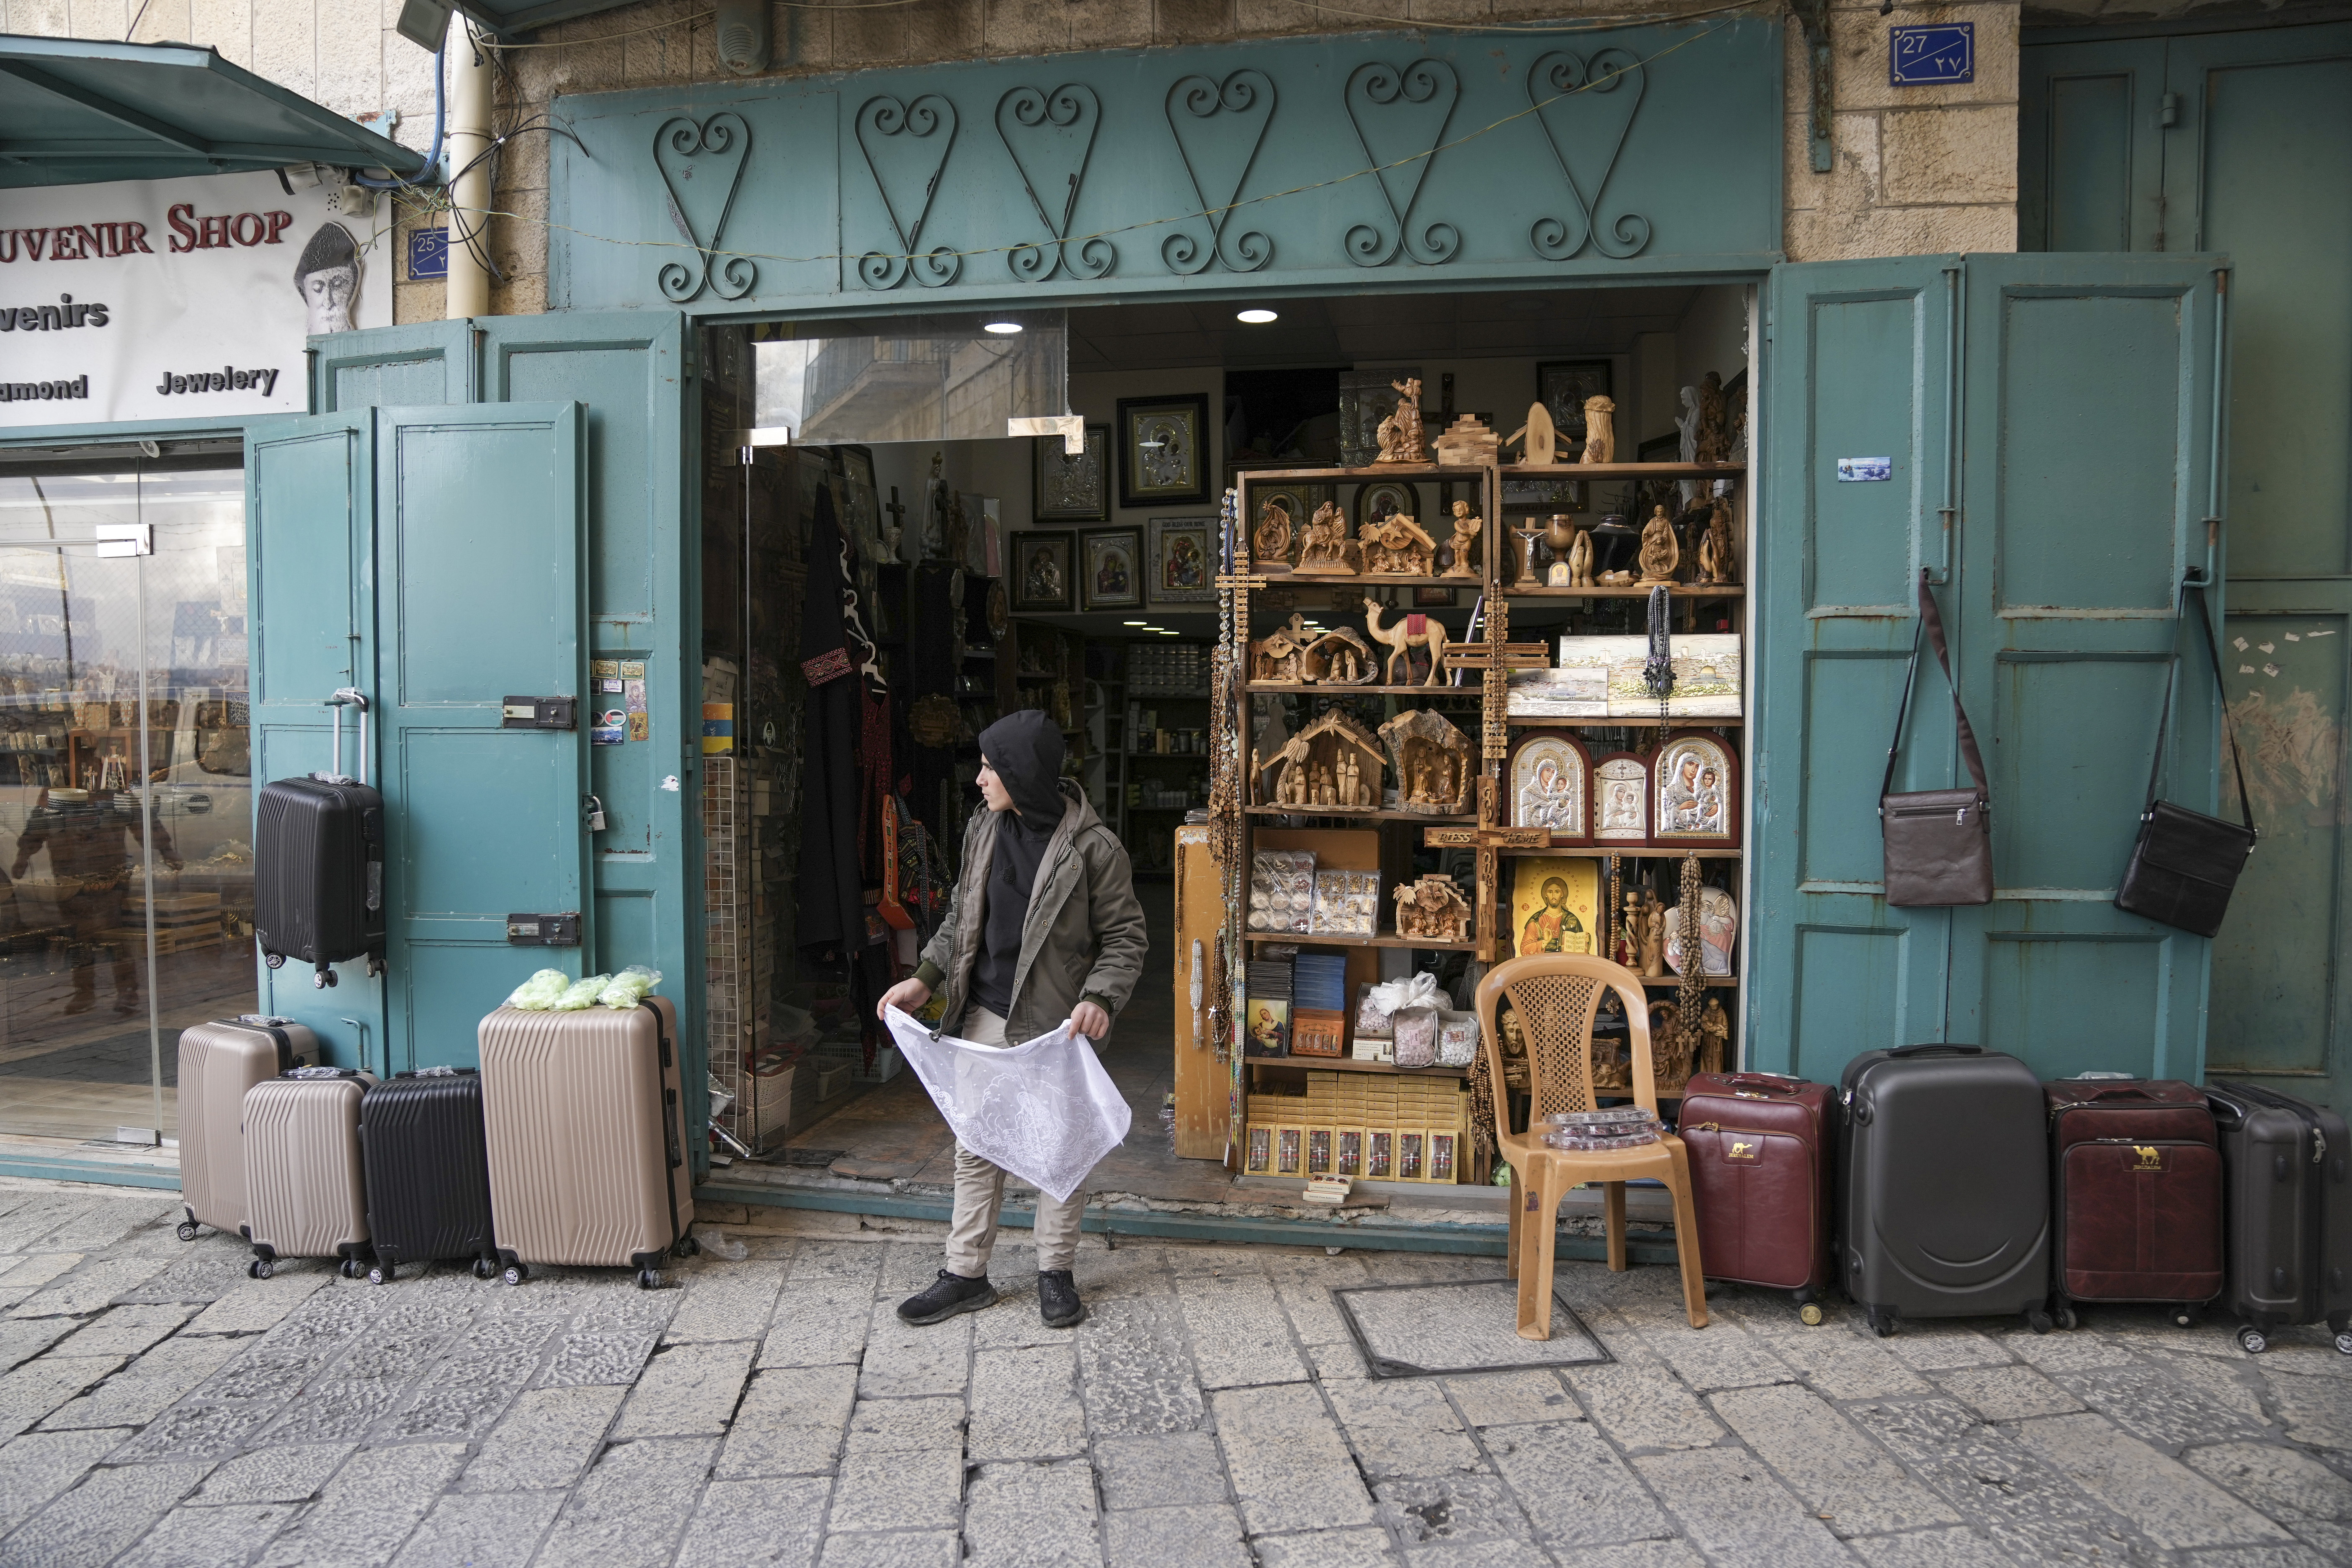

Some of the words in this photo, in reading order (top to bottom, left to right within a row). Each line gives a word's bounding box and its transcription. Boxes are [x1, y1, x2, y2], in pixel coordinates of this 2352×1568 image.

[1903, 35, 1927, 54] 27
[418, 237, 435, 252] 25
[156, 366, 279, 397] Jewelery
[1438, 833, 1471, 843] BLESS
[1506, 833, 1540, 843] HOME
